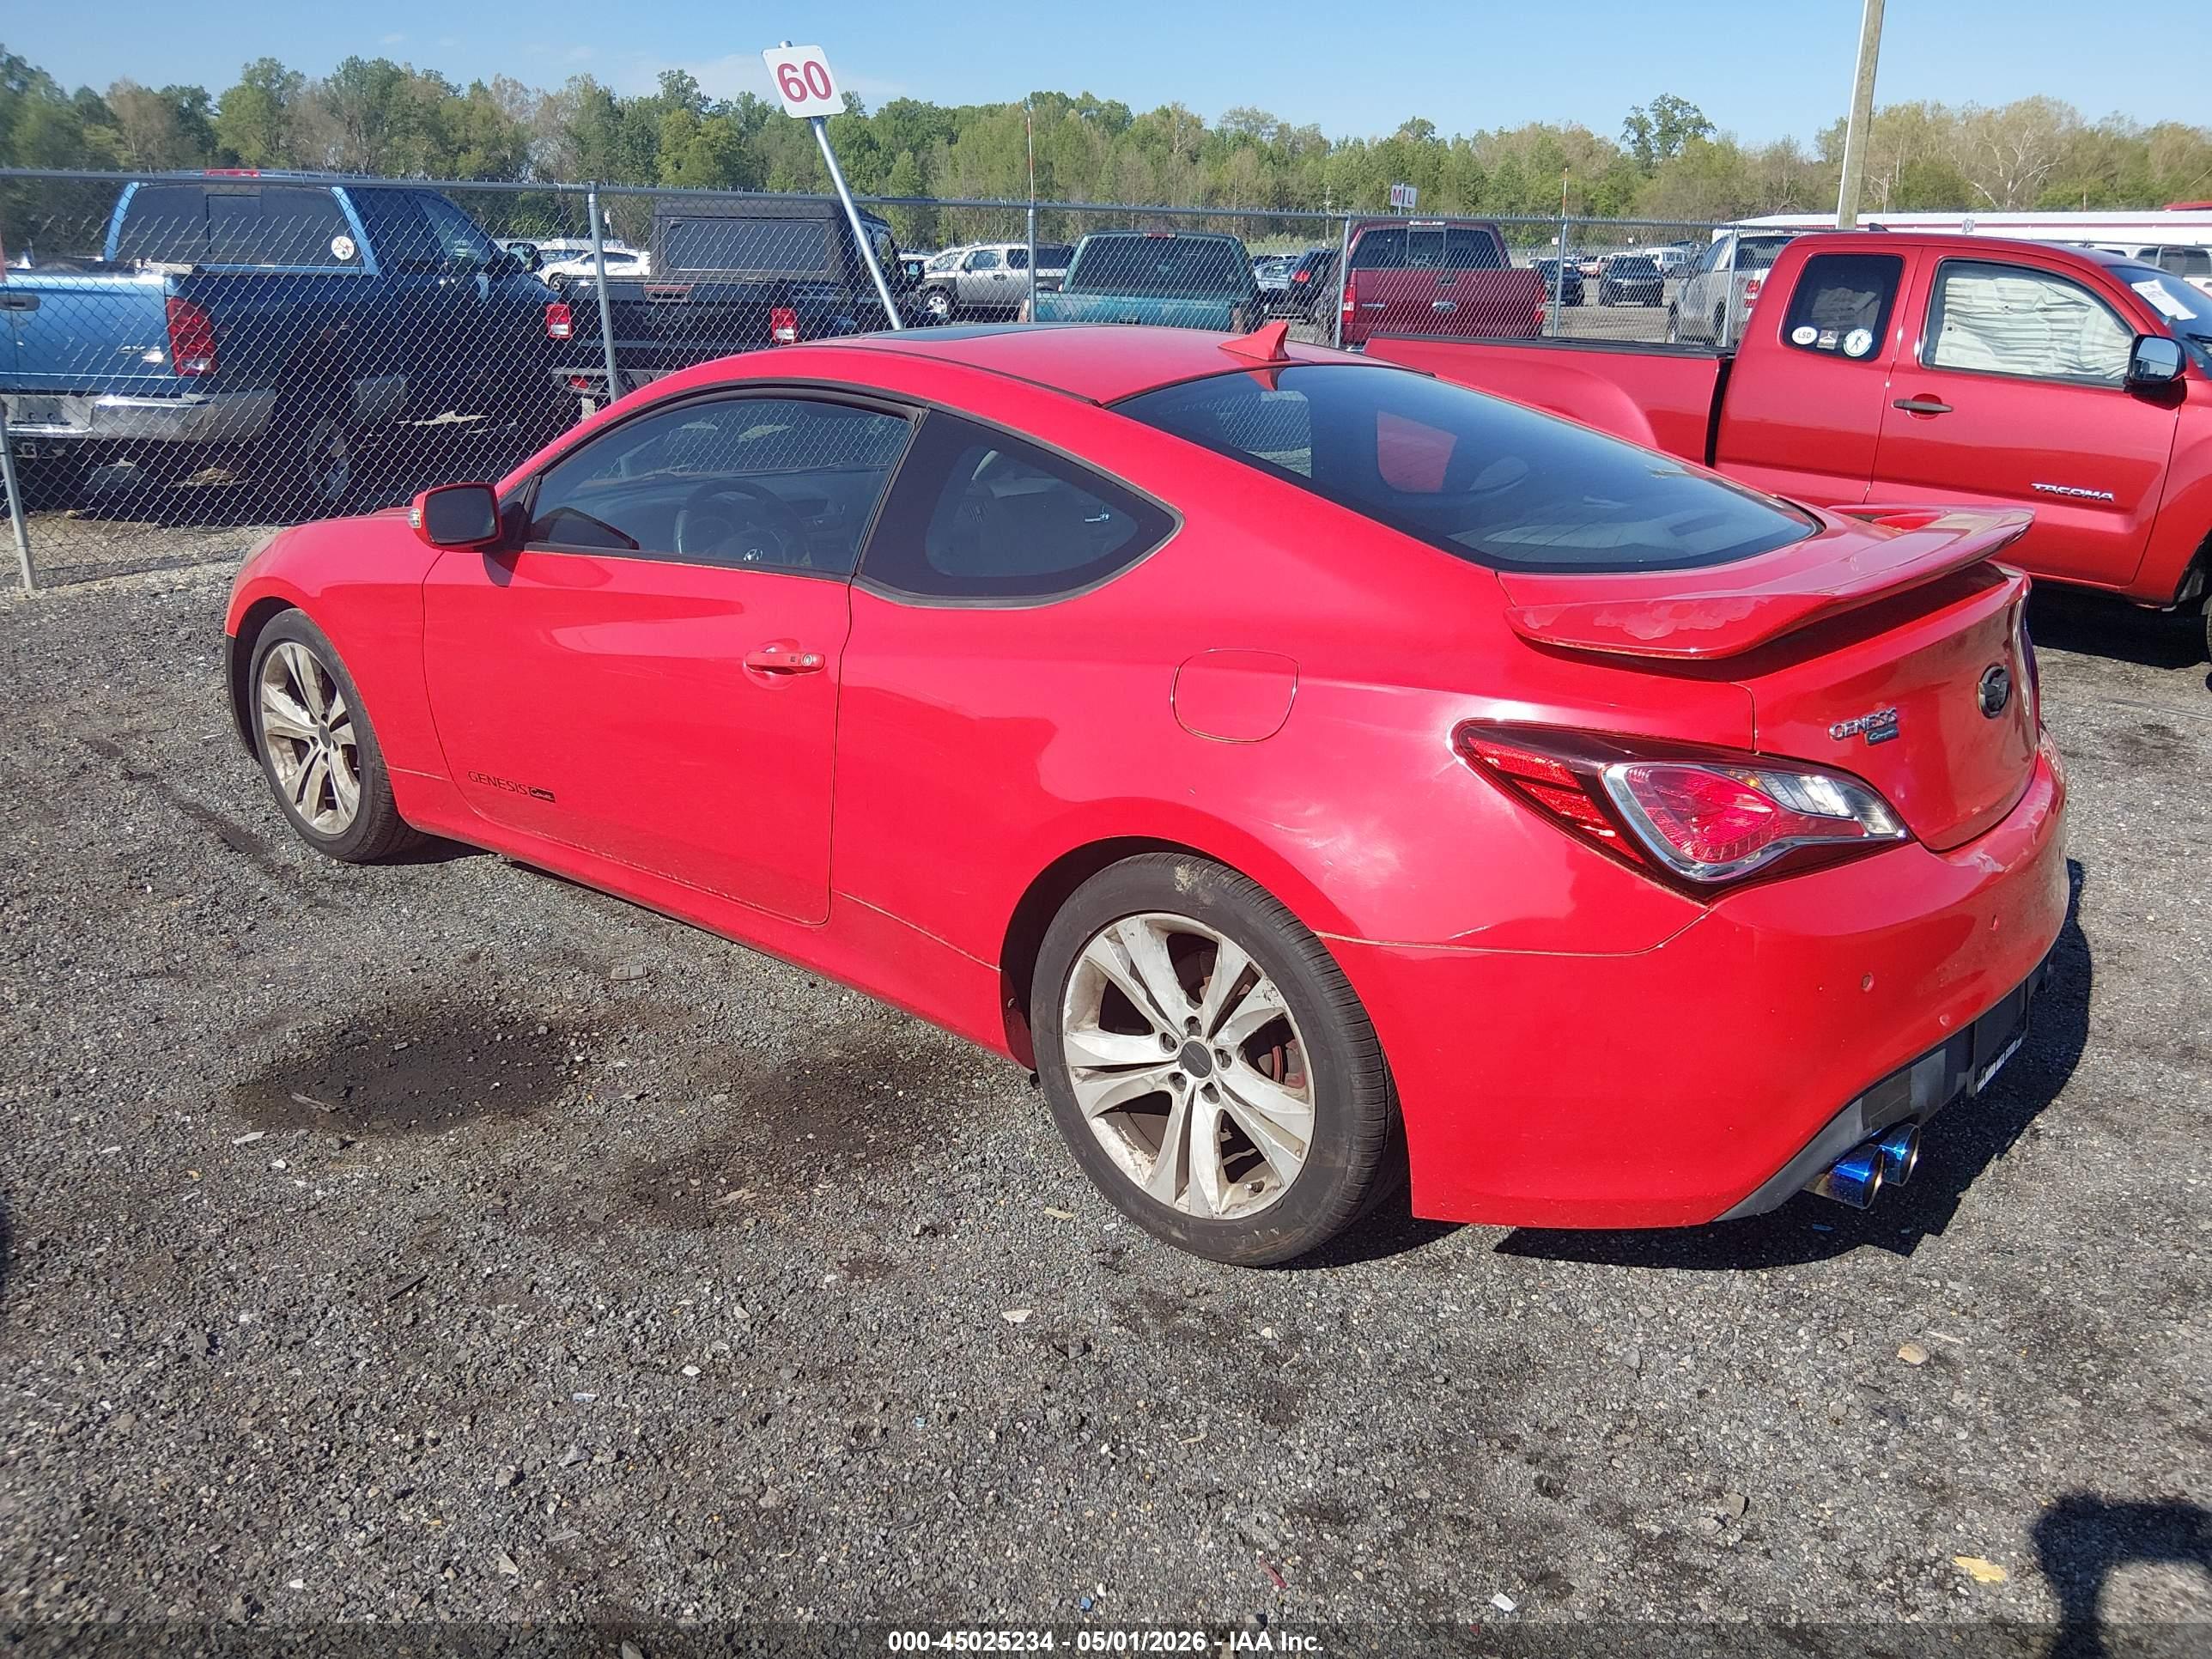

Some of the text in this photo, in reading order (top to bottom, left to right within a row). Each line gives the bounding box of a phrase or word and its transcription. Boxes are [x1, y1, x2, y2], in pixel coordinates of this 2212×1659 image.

[776, 61, 832, 103] 60
[1797, 331, 1812, 339] LSD
[2030, 483, 2114, 502] TACOMA
[1828, 707, 1897, 740] GENESIS
[468, 770, 528, 795] GENESIS
